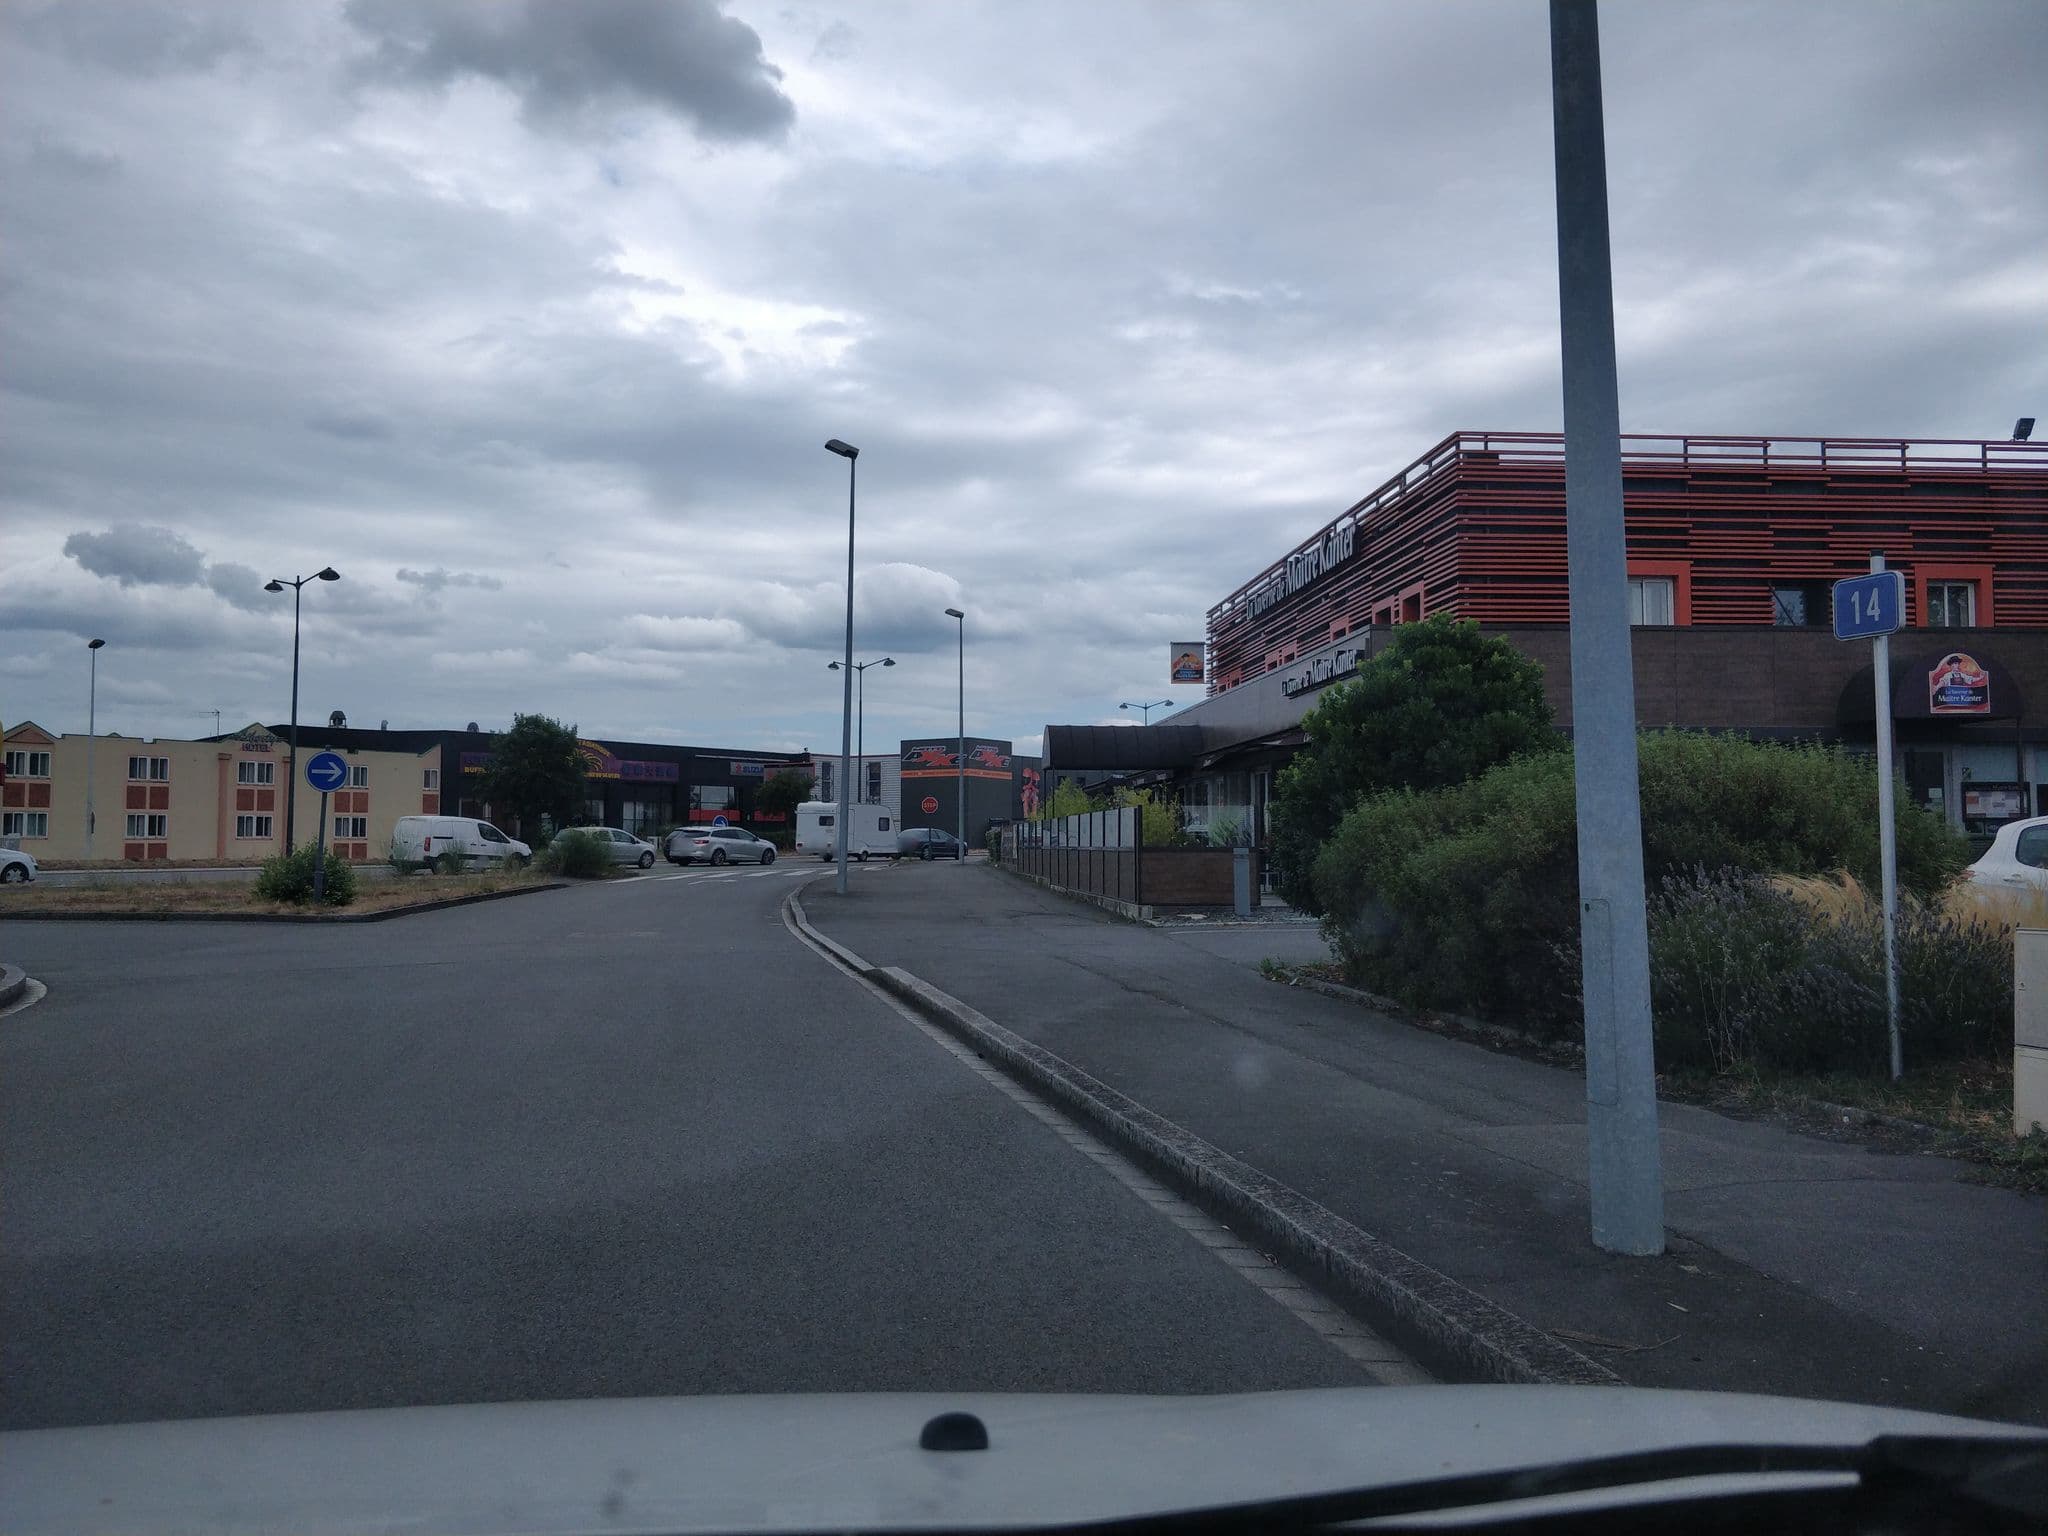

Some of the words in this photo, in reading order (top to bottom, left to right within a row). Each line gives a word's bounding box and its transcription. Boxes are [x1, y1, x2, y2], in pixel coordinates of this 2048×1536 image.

[1319, 524, 1356, 575] Kanter
[1851, 587, 1881, 625] 14
[1332, 647, 1357, 681] Kanter
